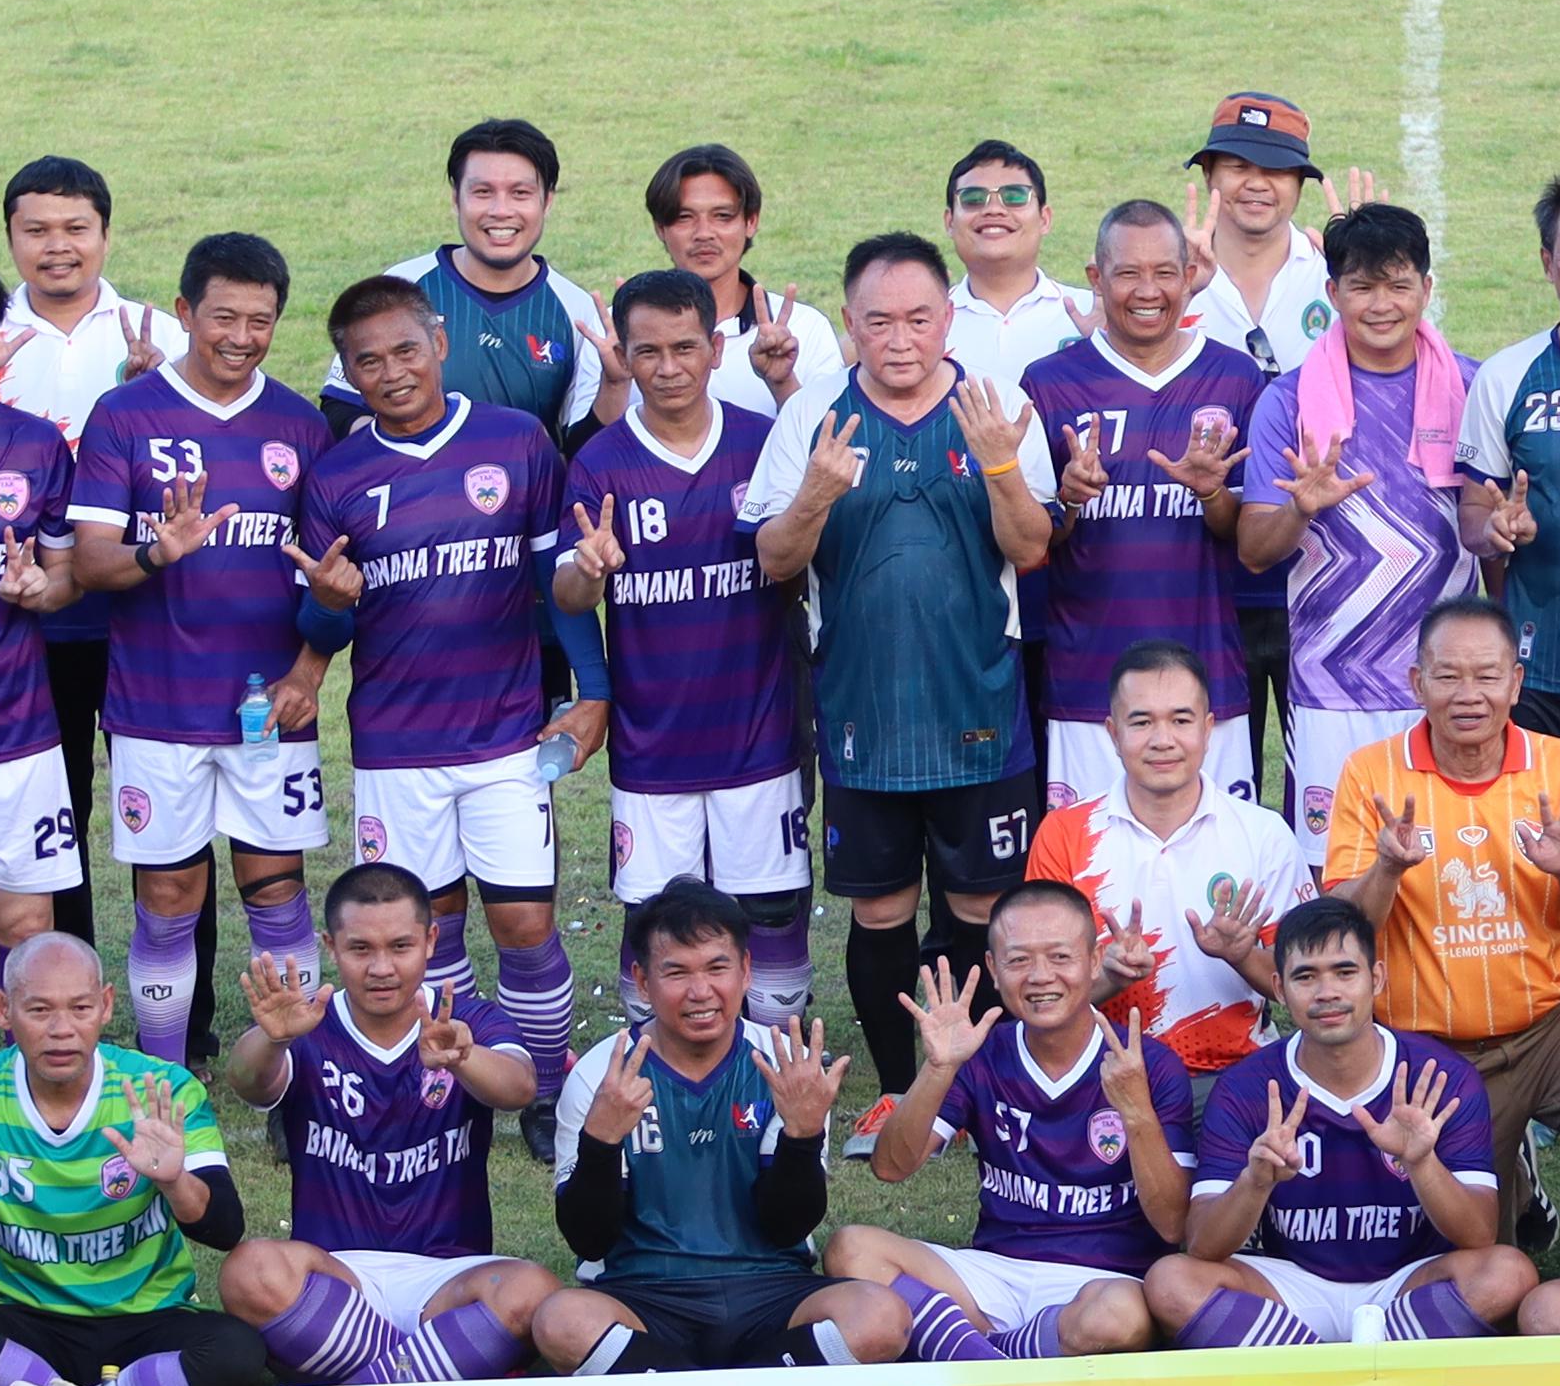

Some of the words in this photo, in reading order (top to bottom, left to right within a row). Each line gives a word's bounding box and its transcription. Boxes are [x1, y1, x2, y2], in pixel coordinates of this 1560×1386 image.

[149, 438, 202, 483] 53
[224, 511, 282, 548] TREE
[366, 484, 391, 531] 7
[627, 497, 668, 545] 18
[435, 537, 491, 579] TREE
[701, 558, 755, 599] TREE
[283, 767, 324, 818] 53
[34, 807, 78, 860] 29
[536, 803, 551, 849] 7
[988, 808, 1028, 860] 57
[1433, 920, 1528, 946] SINGHA
[1450, 945, 1489, 958] LEMON
[1490, 942, 1521, 955] SODA
[384, 1134, 439, 1186] TREE
[1057, 1183, 1112, 1217] TREE
[1344, 1204, 1400, 1241] TREE
[61, 1223, 126, 1266] TREE
[130, 1193, 170, 1236] TAK
